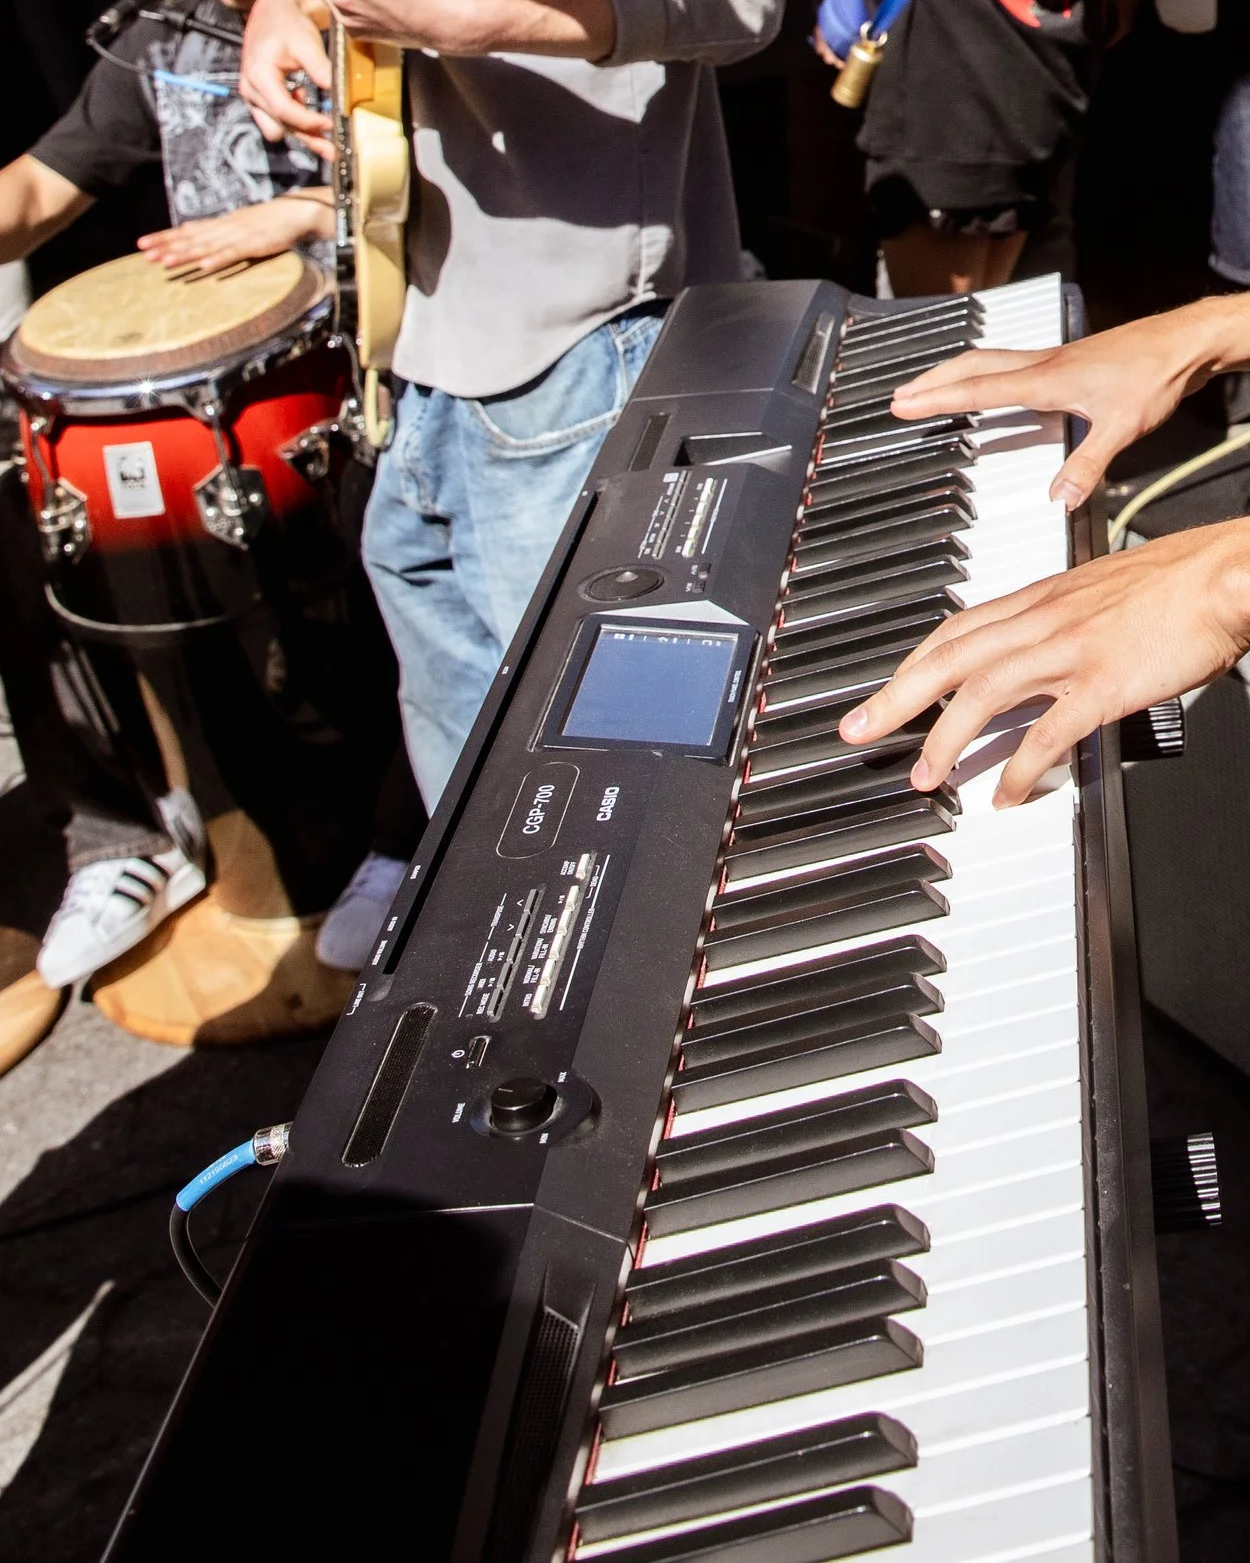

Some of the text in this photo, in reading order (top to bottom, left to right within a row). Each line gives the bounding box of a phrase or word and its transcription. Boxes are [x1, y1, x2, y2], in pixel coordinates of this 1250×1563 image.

[522, 784, 555, 834] CGP-700
[596, 786, 620, 822] CASIO
[582, 908, 595, 933] CONTROLLER
[487, 949, 497, 962] AUDIO
[538, 944, 549, 959] FILL-IN
[469, 962, 482, 984] RECORDER
[530, 968, 541, 983] FILL-IN
[476, 993, 490, 1015] REC MODE
[522, 993, 533, 1007] INTRO
[558, 1071, 567, 1083] MAX
[451, 1102, 466, 1124] VOLUME
[539, 1132, 549, 1144] MIN
